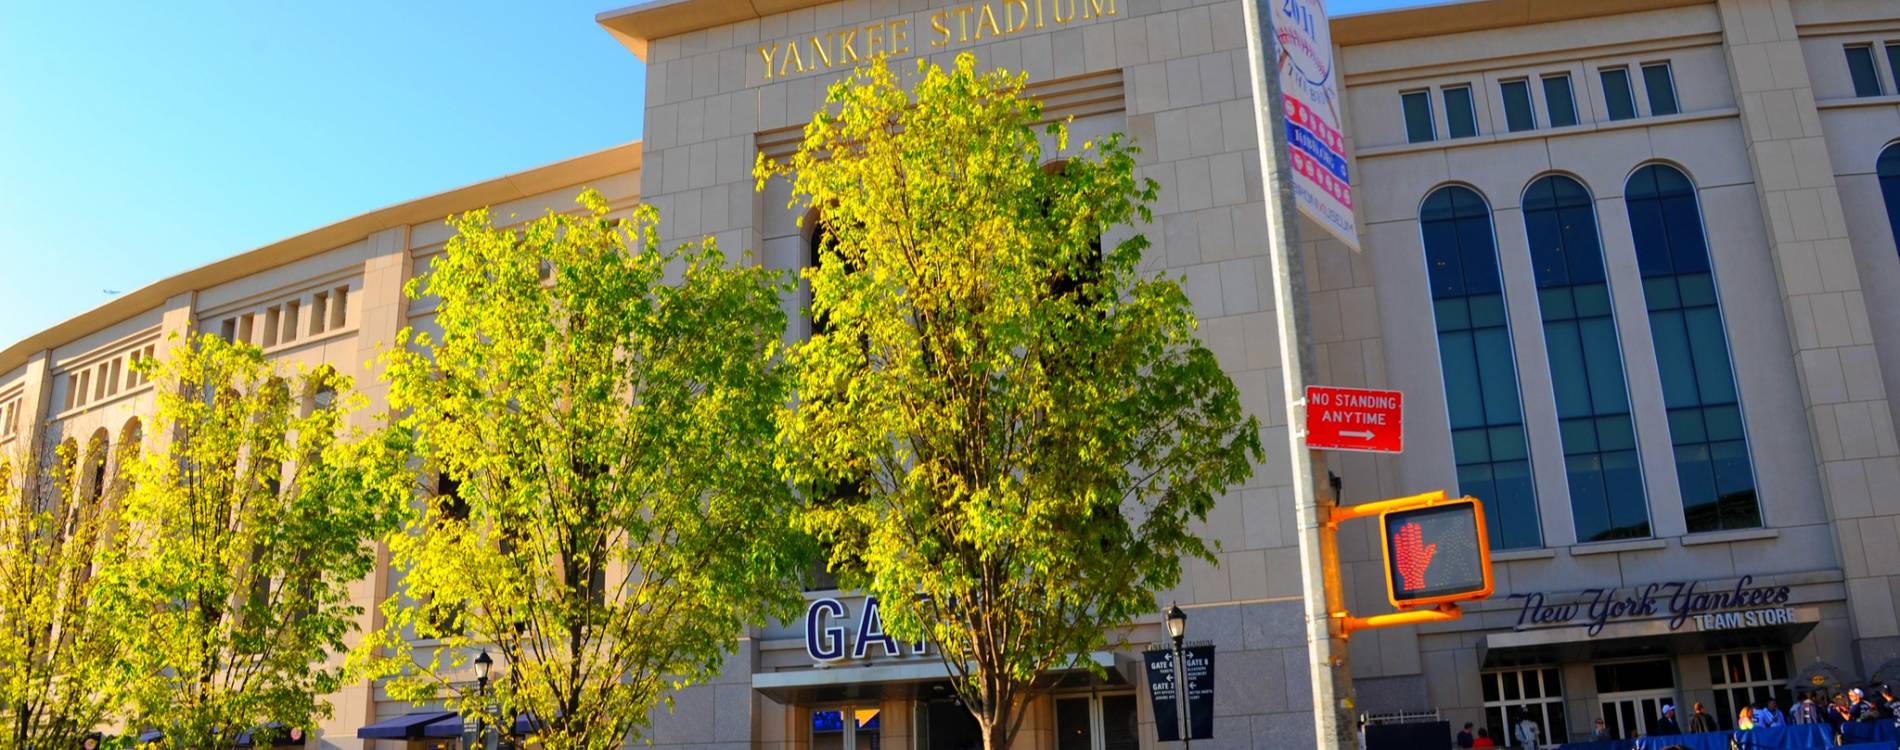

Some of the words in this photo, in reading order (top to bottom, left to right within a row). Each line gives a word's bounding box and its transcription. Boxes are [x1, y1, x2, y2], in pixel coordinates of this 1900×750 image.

[758, 19, 909, 79] YANKEE
[1311, 393, 1329, 405] NO
[1335, 394, 1396, 409] STANDING
[1322, 410, 1386, 425] ANYTIME
[1508, 591, 1578, 632] New
[1579, 583, 1658, 637] York
[1662, 575, 1790, 631] Yankees
[1693, 612, 1743, 632] TEAM
[1744, 607, 1795, 628] STORE
[1151, 662, 1168, 670] GATE
[1152, 682, 1168, 690] GATE
